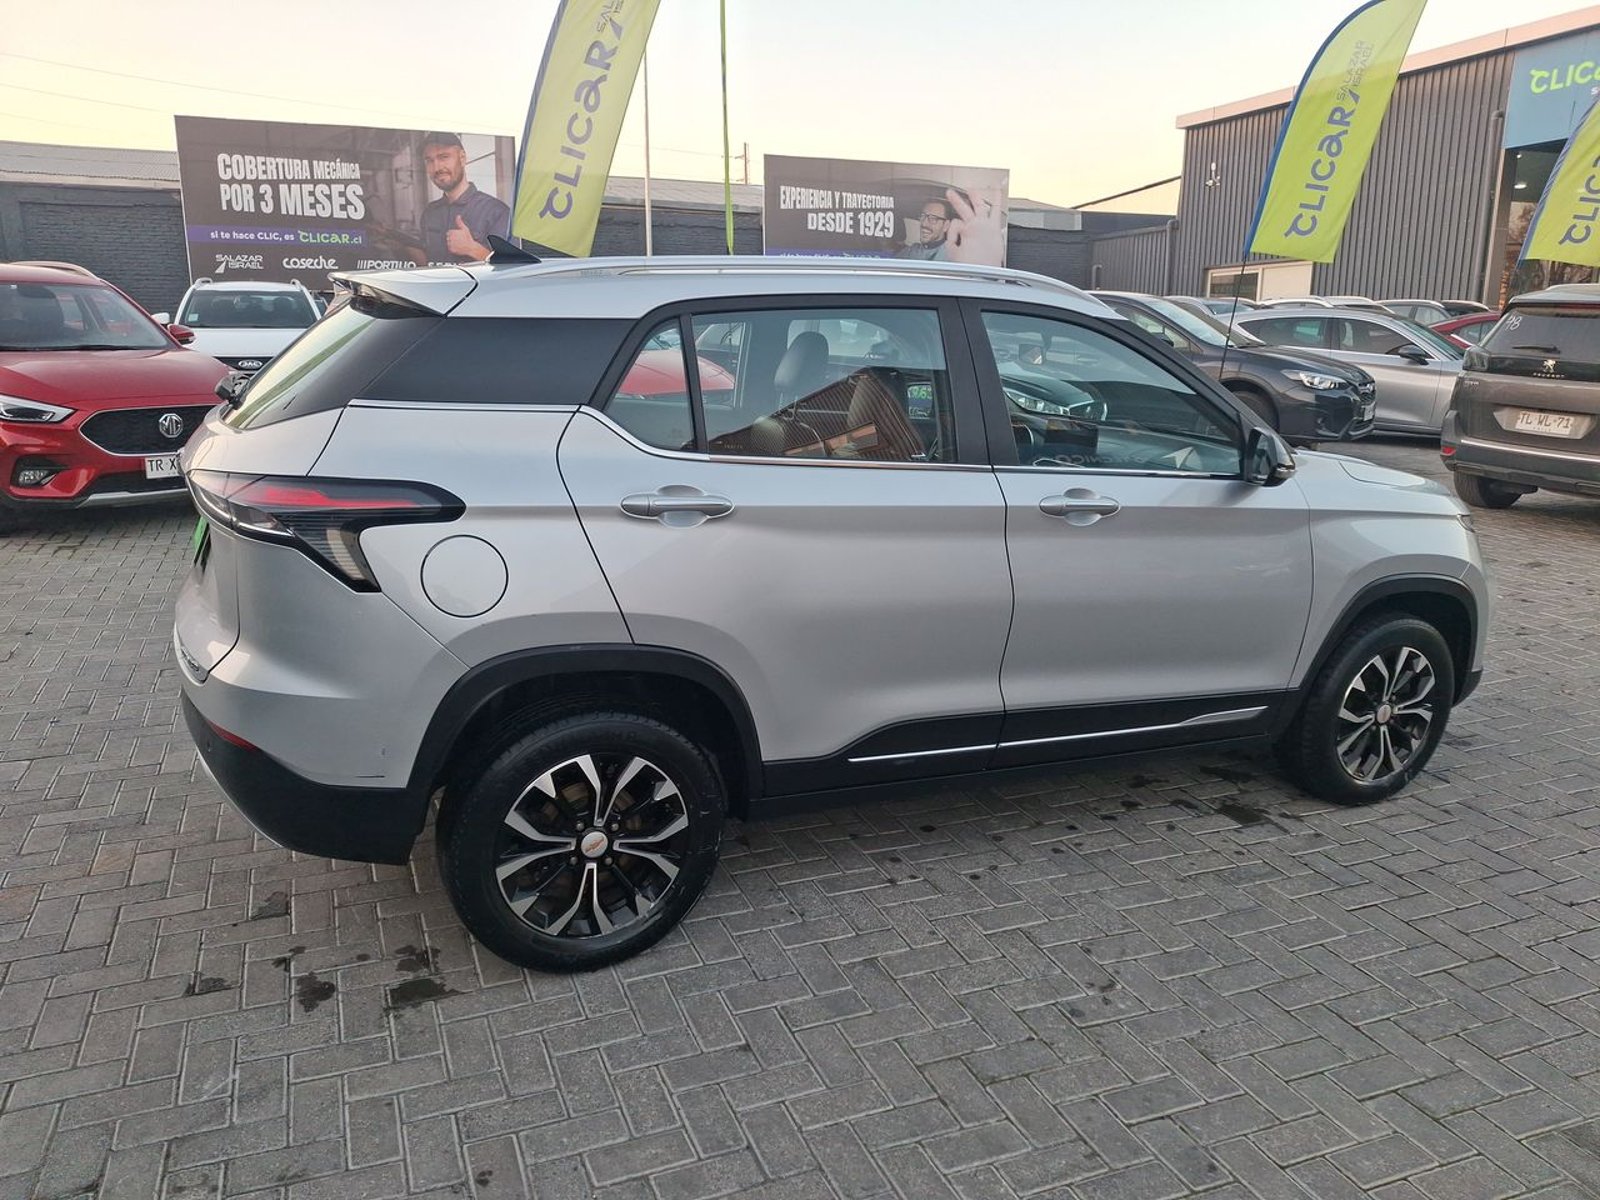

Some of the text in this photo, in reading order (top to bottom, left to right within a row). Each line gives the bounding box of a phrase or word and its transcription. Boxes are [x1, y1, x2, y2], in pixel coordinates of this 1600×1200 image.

[539, 40, 618, 220] CLICAR
[217, 153, 361, 181] COBERTURA MECÁNICA
[1285, 106, 1357, 238] CLICAR
[219, 183, 366, 220] POR 3 MESES
[780, 185, 895, 210] EXPERIENCIA Y TRAYECTORIA
[210, 230, 219, 239] si
[220, 231, 231, 240] te
[232, 231, 255, 241] hace
[256, 232, 282, 242] CLIC,
[807, 210, 895, 239] DESDE 1929
[282, 255, 339, 270] coseche
[147, 459, 164, 472] TR
